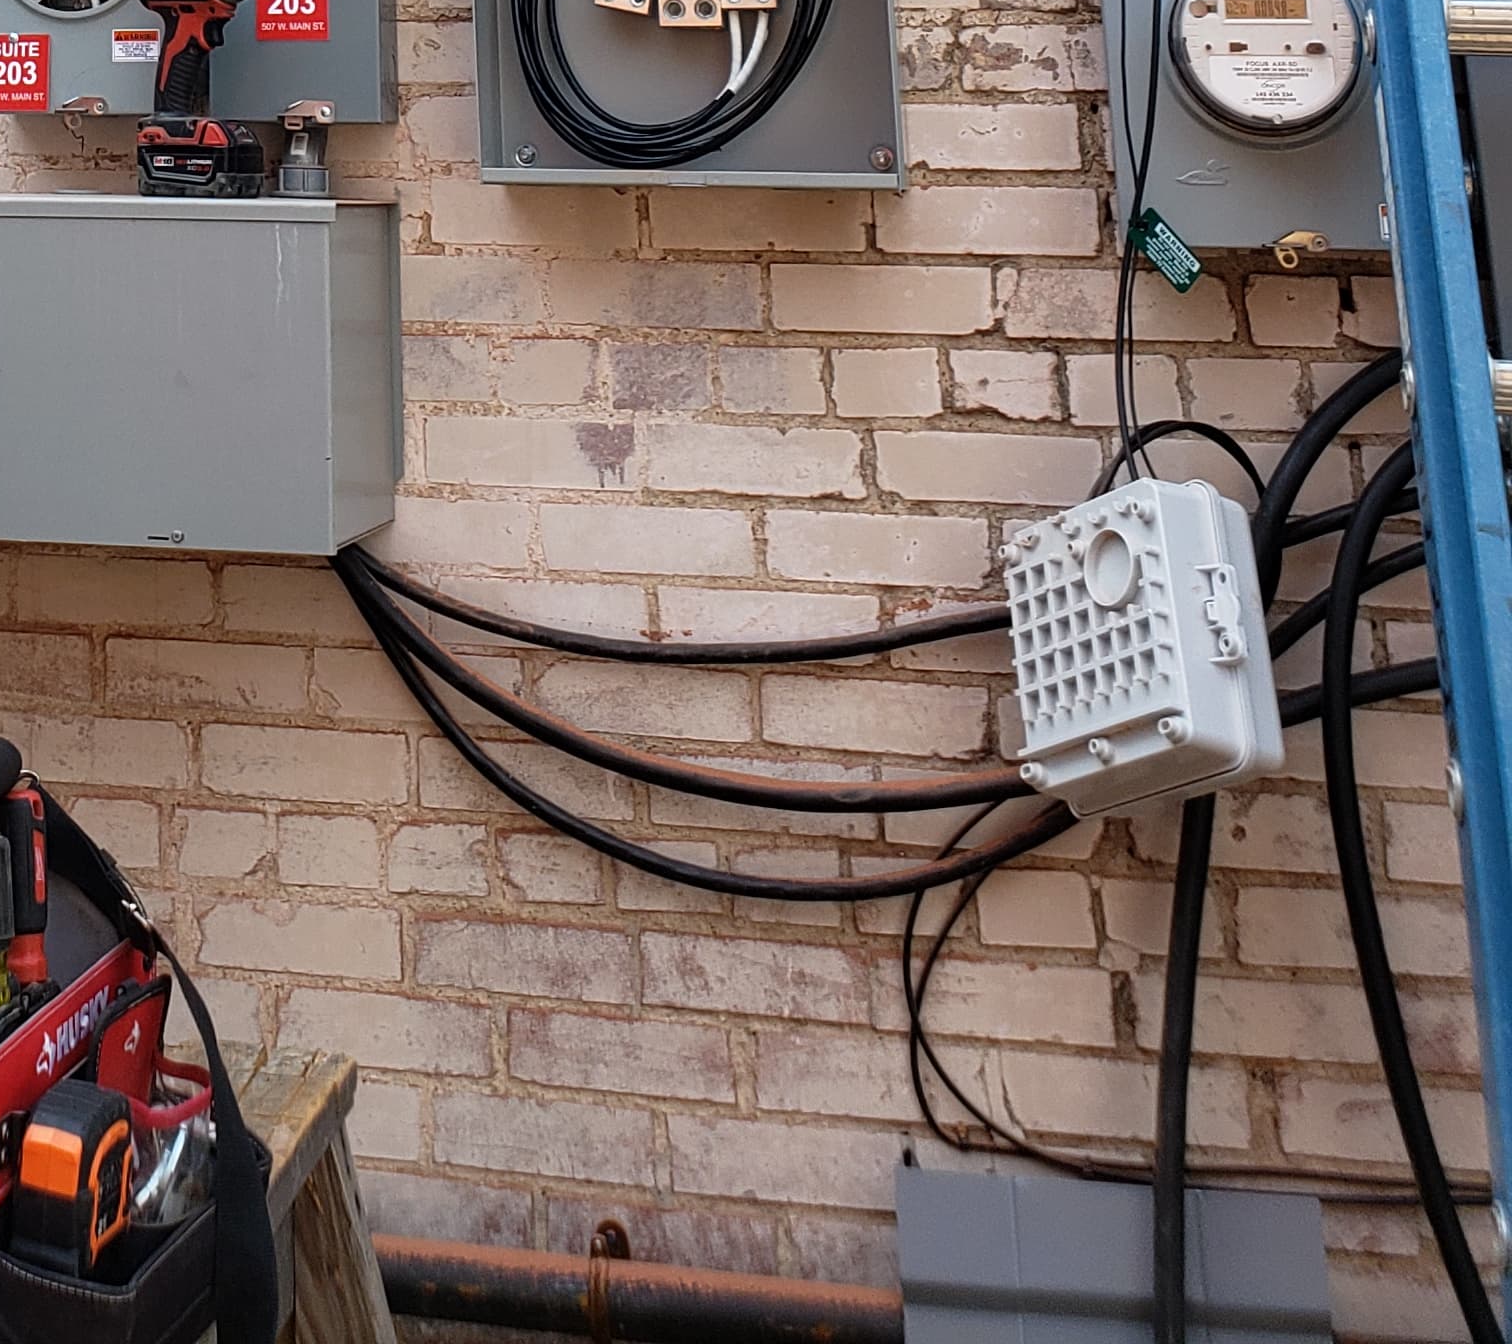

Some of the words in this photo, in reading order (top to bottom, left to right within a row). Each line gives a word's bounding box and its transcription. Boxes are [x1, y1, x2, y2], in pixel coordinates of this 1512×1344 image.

[261, 22, 276, 31] 507
[289, 22, 311, 31] MAIN
[0, 92, 10, 101] W.
[11, 92, 32, 101] MAIN
[33, 92, 46, 101] ST.
[1159, 226, 1197, 268] WARNING
[56, 984, 110, 1062] HUSKY
